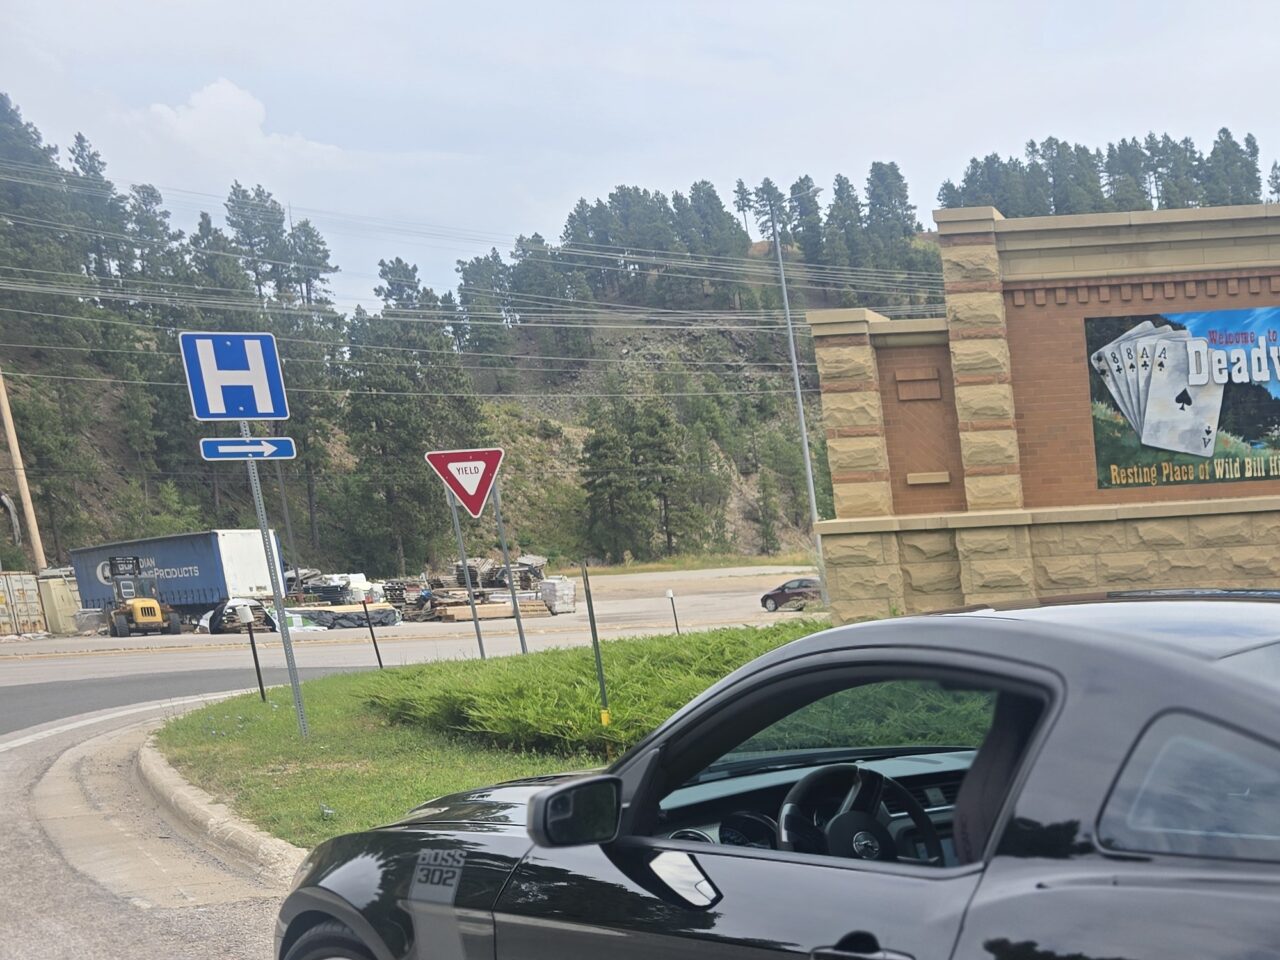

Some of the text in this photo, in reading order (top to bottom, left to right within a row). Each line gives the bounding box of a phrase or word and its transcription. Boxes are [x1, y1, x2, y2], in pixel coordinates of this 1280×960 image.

[1208, 329, 1278, 346] Welcome to
[1110, 346, 1168, 365] 8 8 A A
[195, 339, 274, 414] H
[1202, 437, 1212, 449] A
[456, 466, 479, 475] YIELD
[1110, 463, 1157, 487] Resting
[1161, 462, 1195, 482] Place
[1199, 460, 1210, 480] of
[1213, 456, 1240, 479] Wild
[1244, 455, 1265, 478] Bill
[416, 848, 468, 868] BOSS
[417, 867, 457, 886] 302
